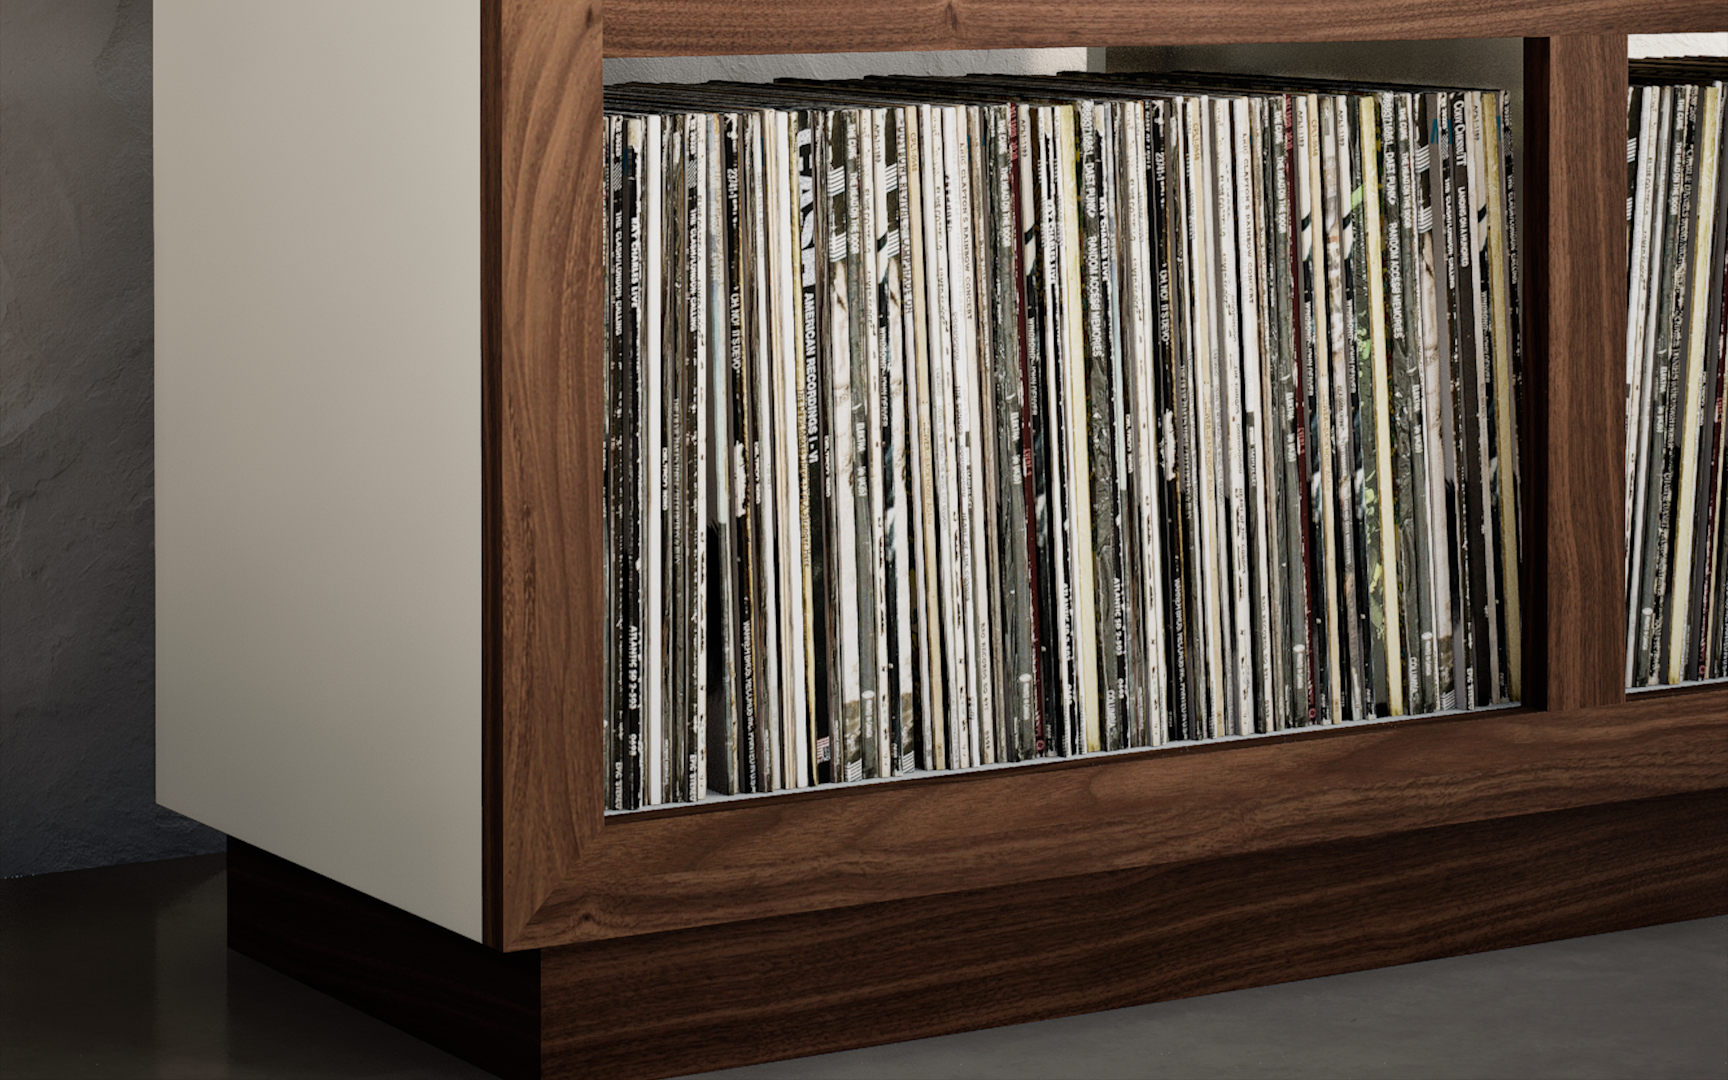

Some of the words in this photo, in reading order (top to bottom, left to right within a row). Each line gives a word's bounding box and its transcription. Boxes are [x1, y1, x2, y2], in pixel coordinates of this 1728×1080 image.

[1274, 111, 1282, 124] THE
[847, 124, 856, 136] THE
[1274, 126, 1283, 144] CURE
[848, 139, 857, 159] CURE
[1276, 156, 1285, 169] THE
[849, 173, 858, 185] THE
[1276, 171, 1285, 188] HEAD
[850, 187, 858, 206] HEAD
[1277, 200, 1286, 213] THE
[798, 129, 816, 287] CASH
[630, 217, 639, 238] RAY
[850, 219, 859, 232] THE
[1278, 214, 1287, 233] DOOR
[851, 234, 859, 254] DOOR
[1388, 223, 1398, 258] RANDOM
[631, 243, 639, 282] CHARLES
[1088, 236, 1098, 273] RANDOM
[1389, 260, 1400, 293] ACCESS
[631, 286, 639, 308] LIVE
[1090, 276, 1100, 310] ACCESS
[614, 301, 622, 335] CALLING
[689, 297, 697, 331] CALLING
[804, 293, 816, 355] AMERICAN
[1392, 295, 1402, 338] MEMORIES
[1092, 312, 1103, 357] MEMORIES
[806, 358, 817, 432] RECORDINGS
[808, 450, 819, 463] VI
[629, 625, 638, 667] ATLANTIC
